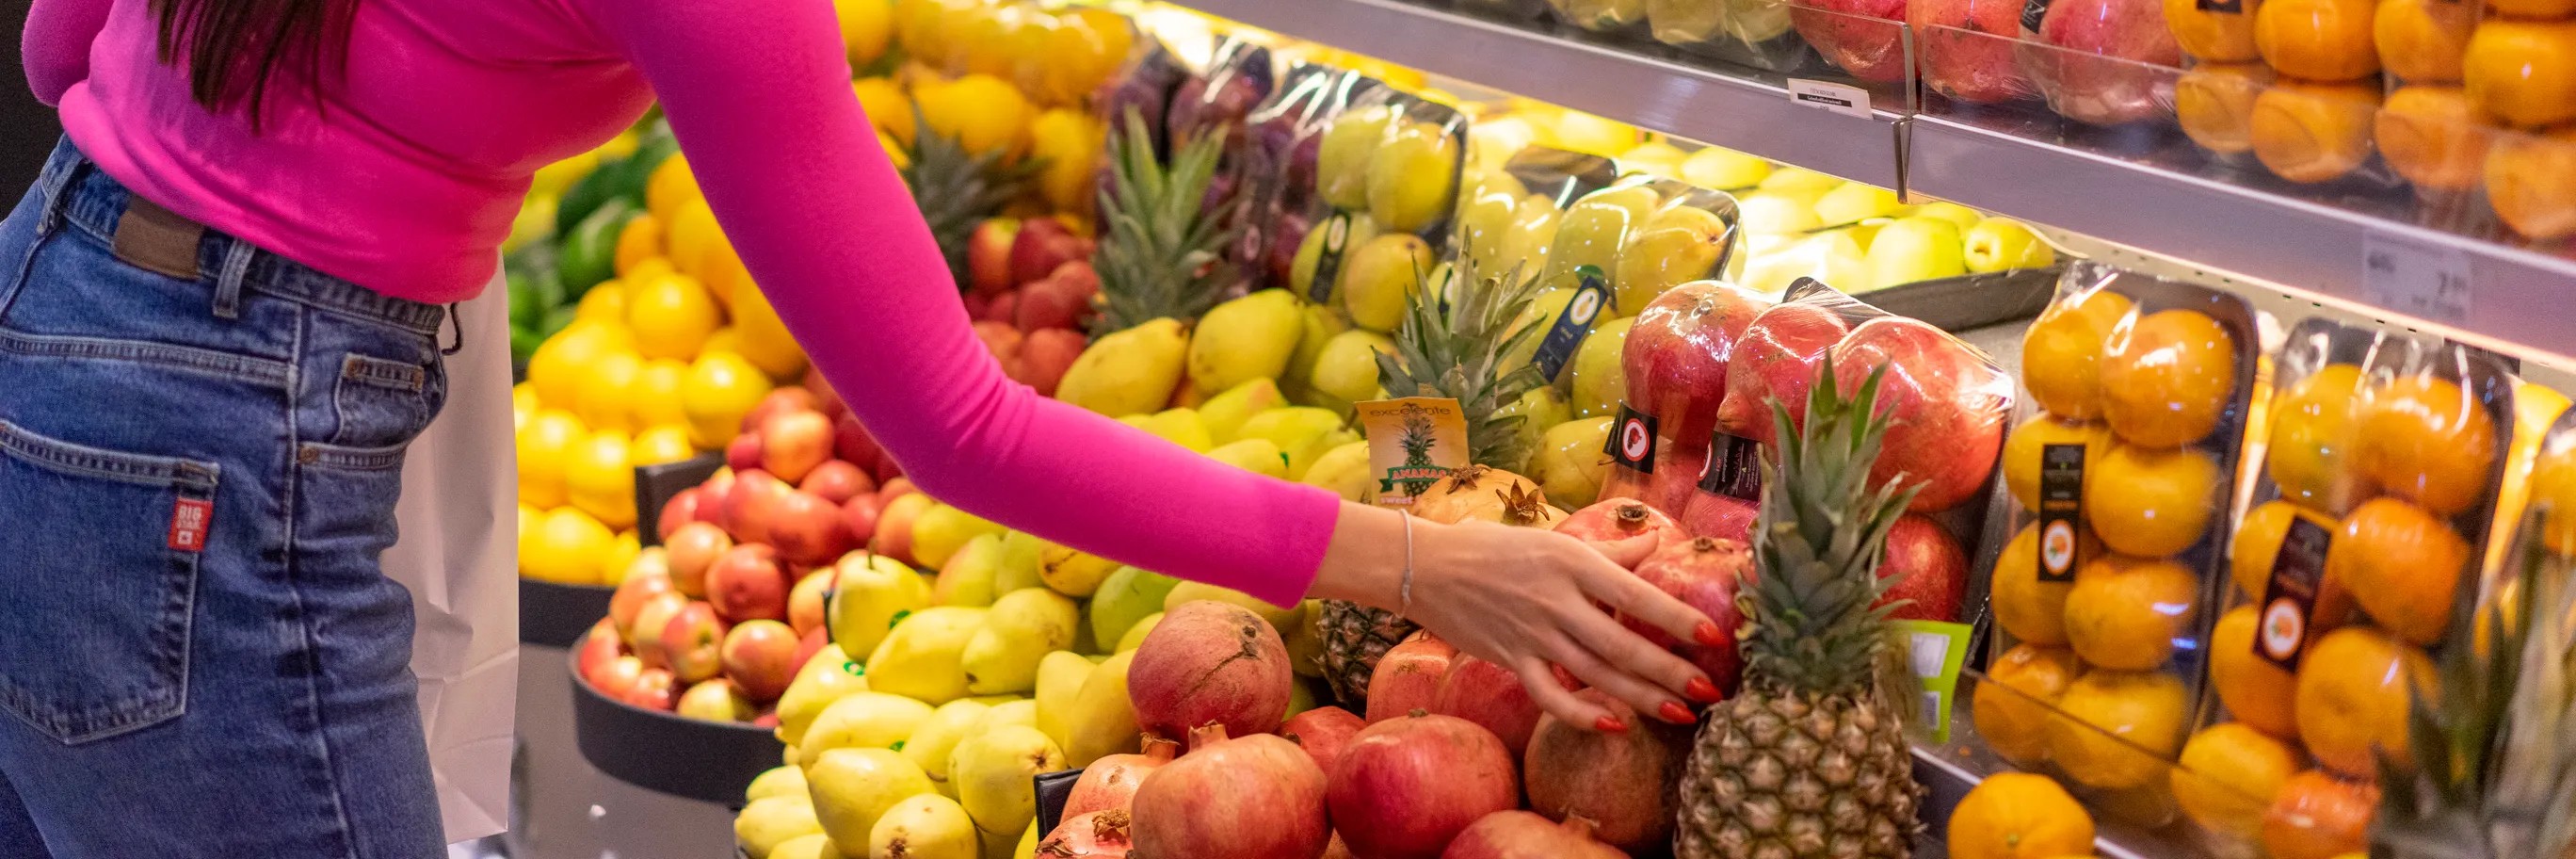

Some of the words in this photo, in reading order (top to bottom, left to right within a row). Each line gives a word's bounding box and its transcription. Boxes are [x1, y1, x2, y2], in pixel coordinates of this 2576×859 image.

[1370, 406, 1451, 416] excelente
[1392, 468, 1447, 480] ANANAS
[178, 506, 202, 520] BIG
